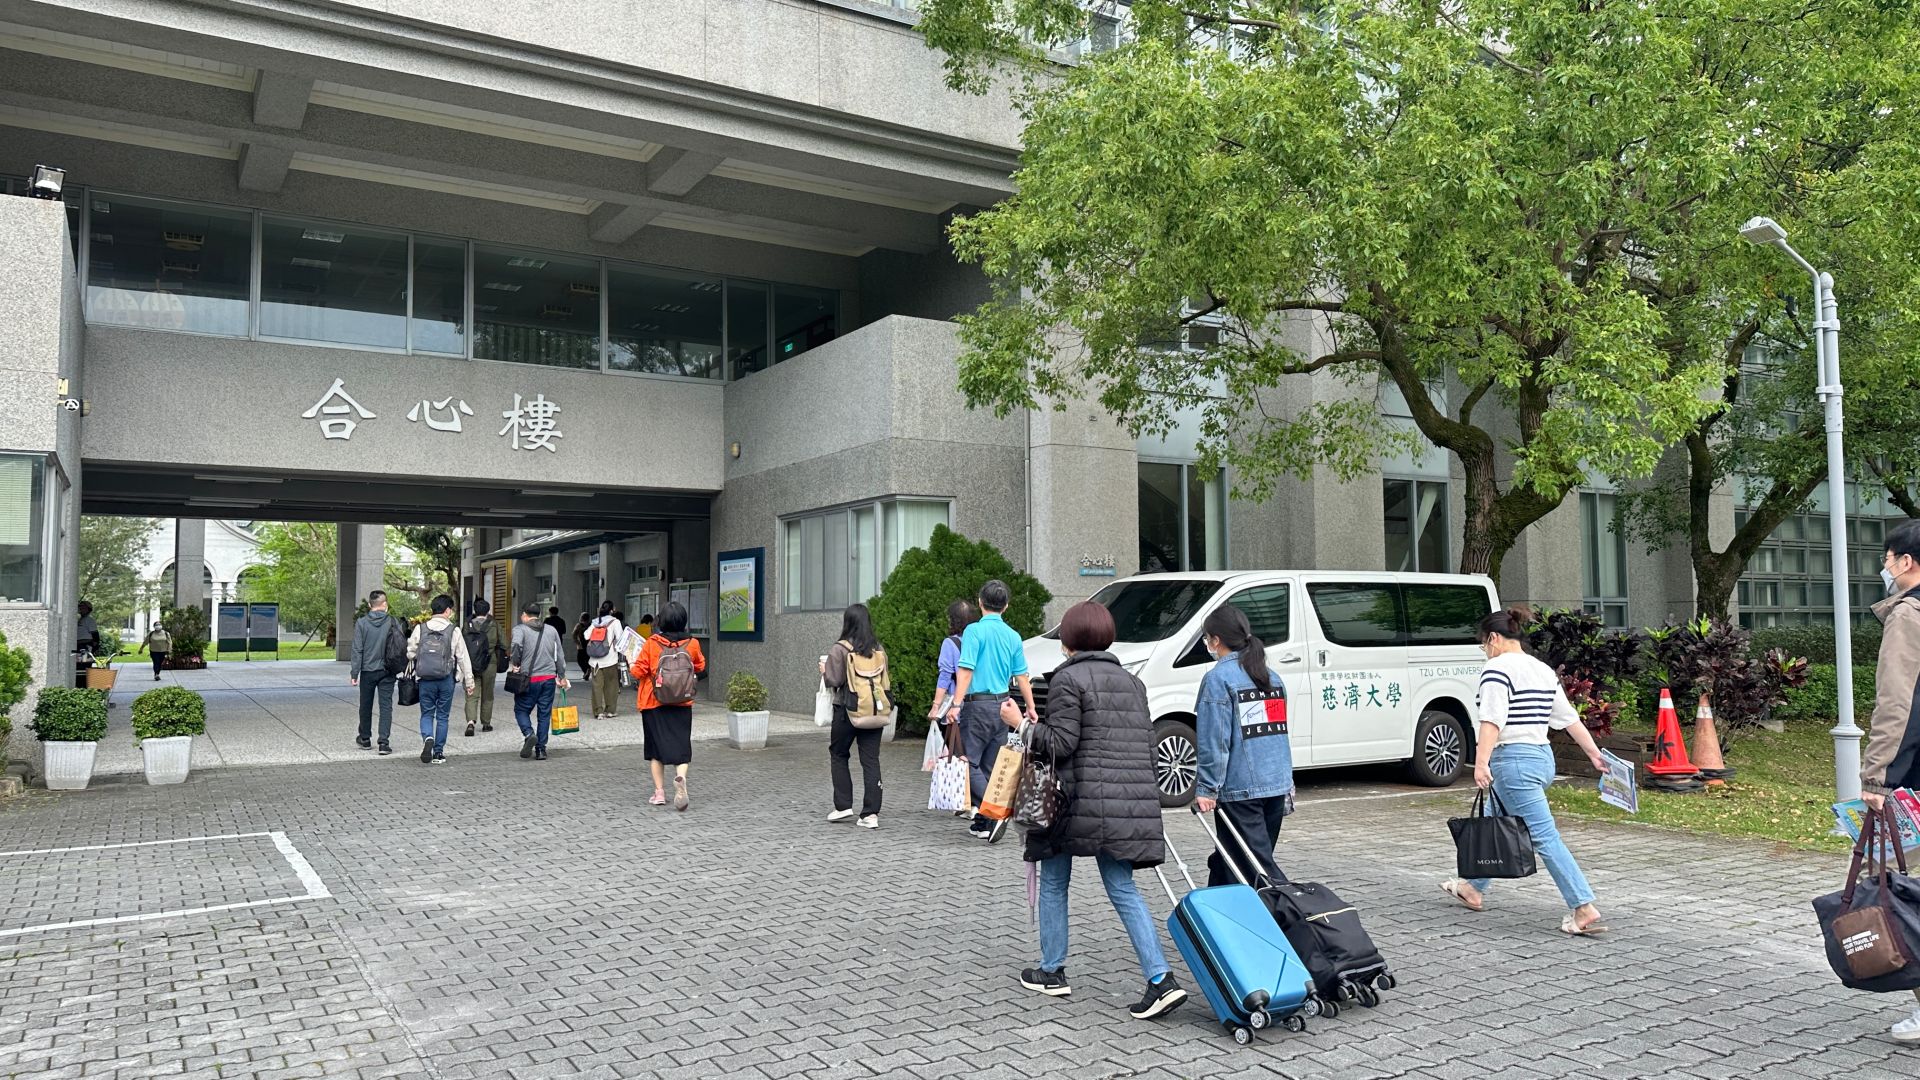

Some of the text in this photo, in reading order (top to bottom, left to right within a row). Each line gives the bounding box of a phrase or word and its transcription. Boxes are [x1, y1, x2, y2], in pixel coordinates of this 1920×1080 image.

[301, 377, 563, 453] 合心樓
[1080, 553, 1116, 567] 合心樓
[1419, 668, 1434, 677] TZU
[1436, 667, 1450, 677] CHI
[1322, 681, 1402, 711] 慈濟大學
